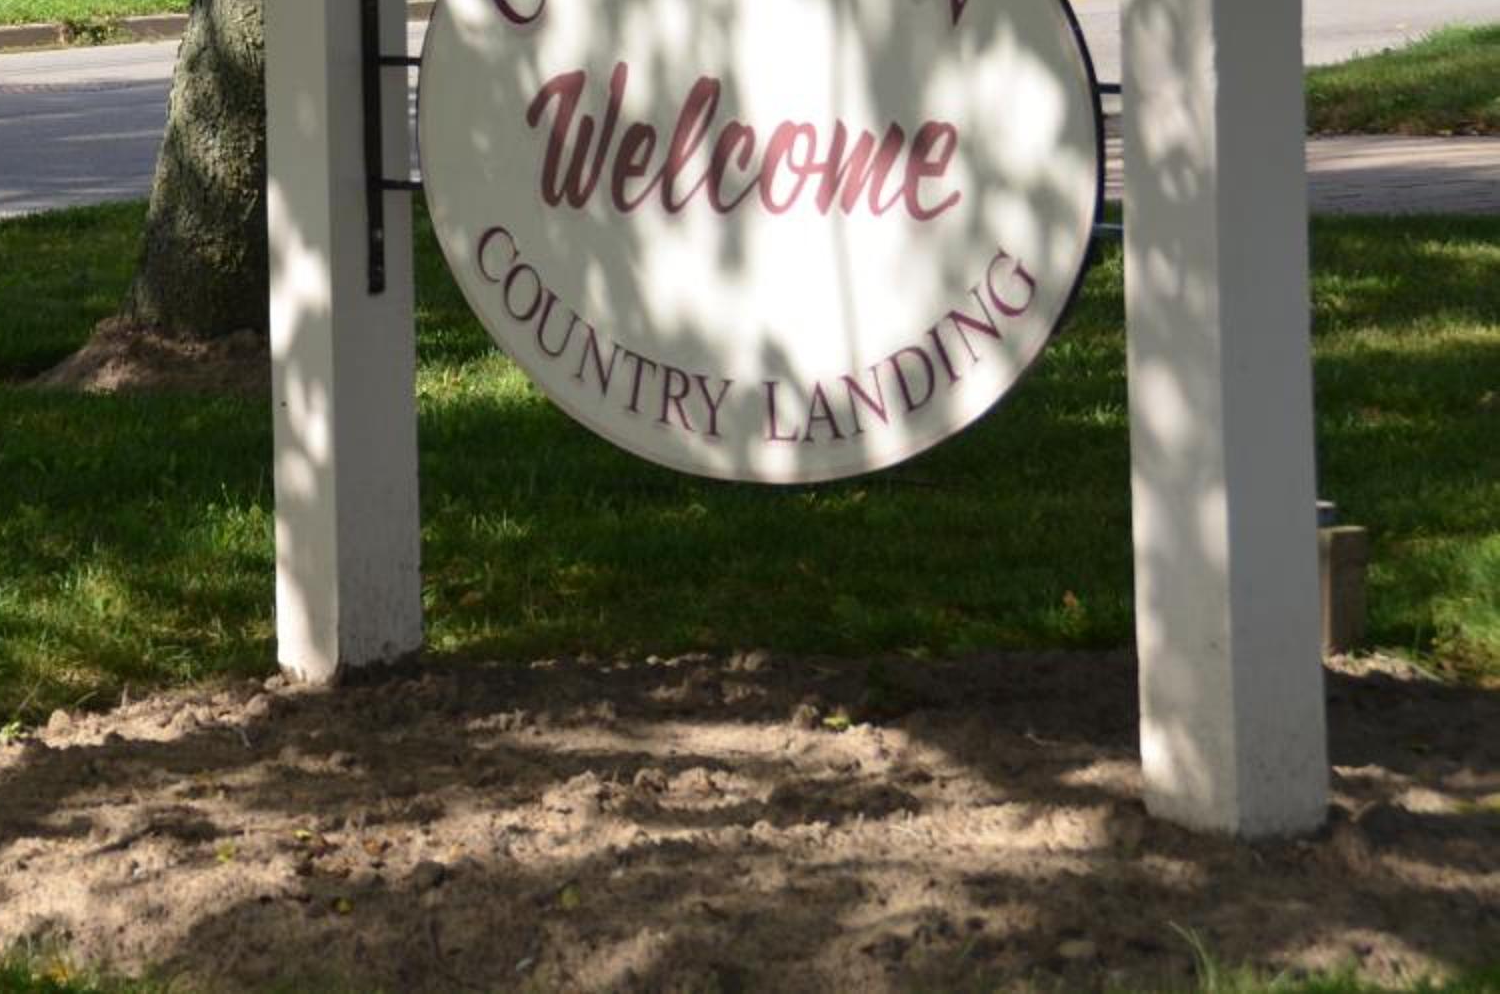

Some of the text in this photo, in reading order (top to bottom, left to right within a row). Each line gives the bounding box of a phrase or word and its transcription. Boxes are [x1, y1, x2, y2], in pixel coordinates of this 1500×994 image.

[526, 61, 962, 221] Welcome
[477, 225, 1038, 442] COUNTRY LANDING
